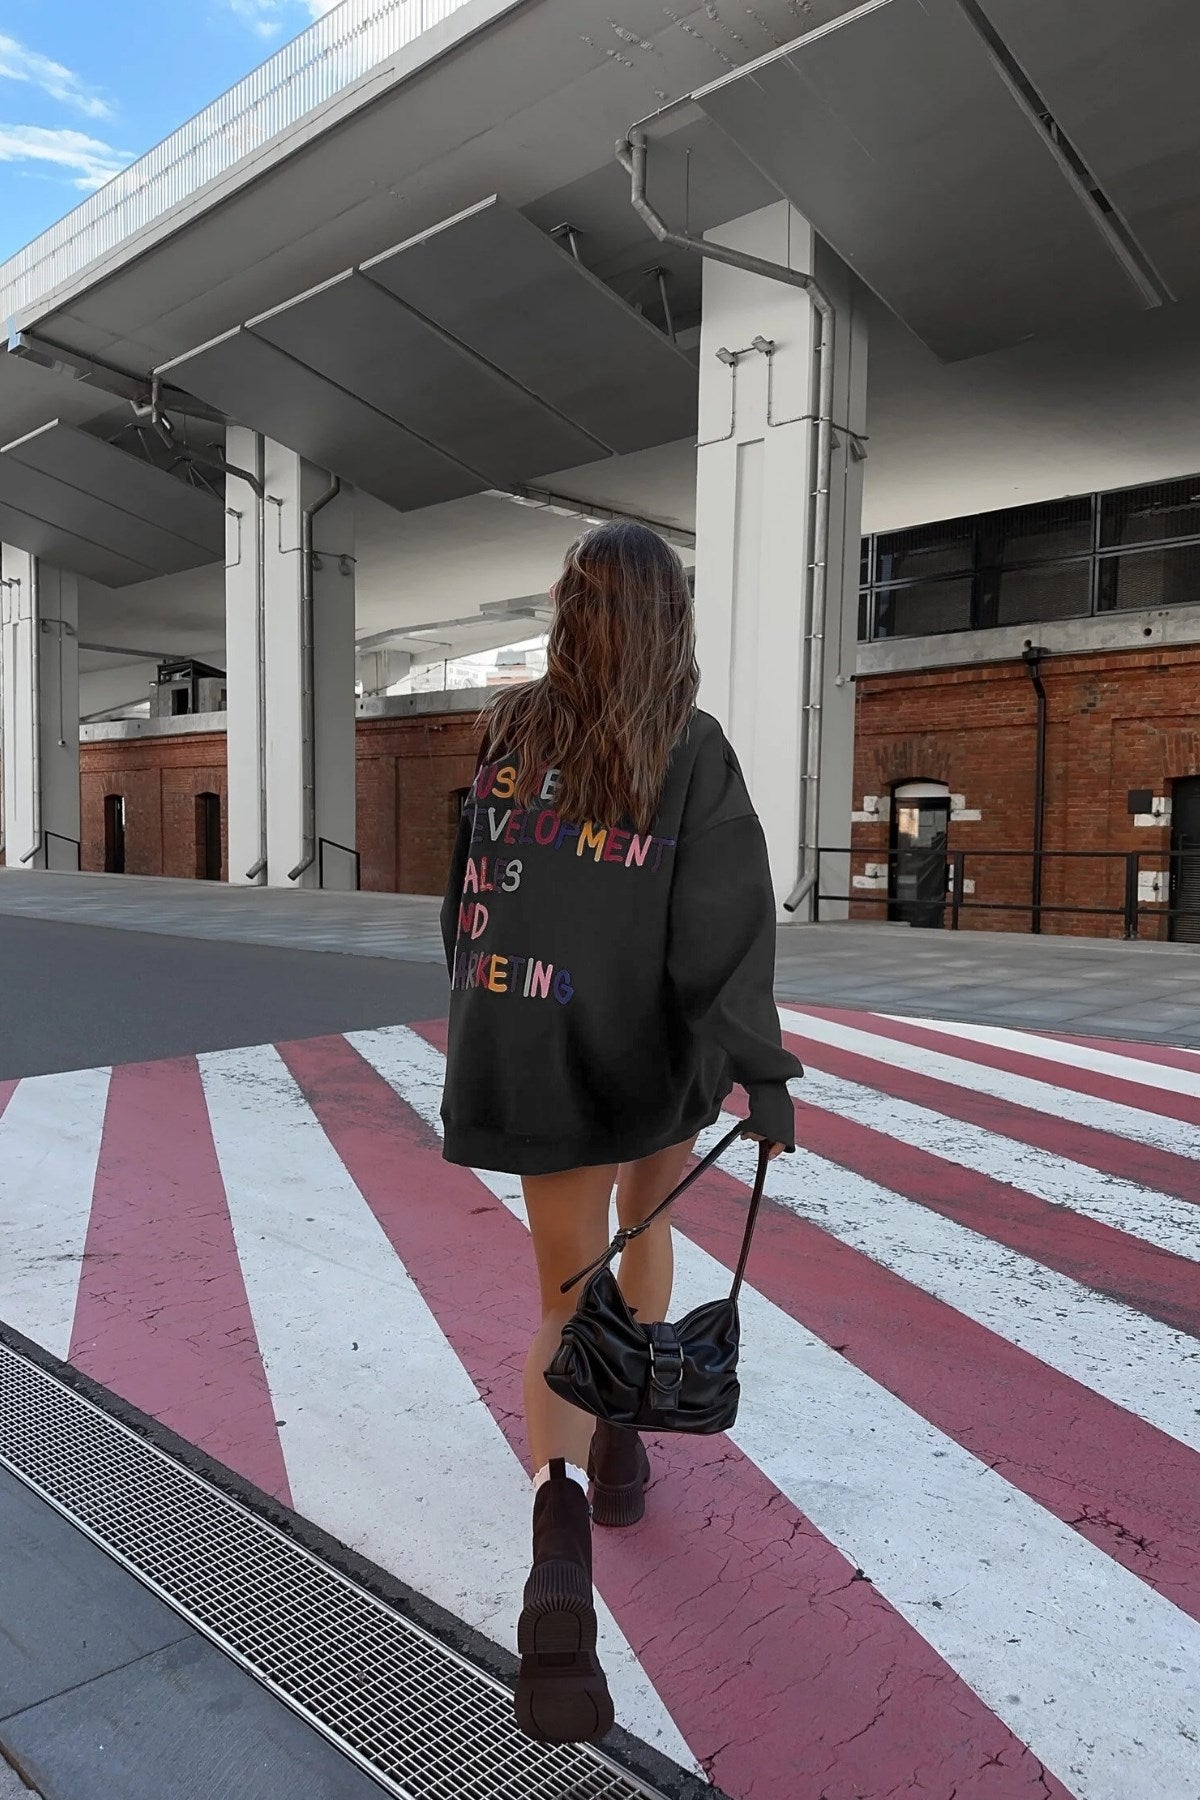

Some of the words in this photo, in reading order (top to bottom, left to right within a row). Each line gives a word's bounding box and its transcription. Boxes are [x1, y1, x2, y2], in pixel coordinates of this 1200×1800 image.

[464, 806, 675, 874] EVELOPMENT
[463, 855, 523, 895] ALES
[458, 902, 490, 940] ND
[452, 948, 576, 1006] ARKETING
